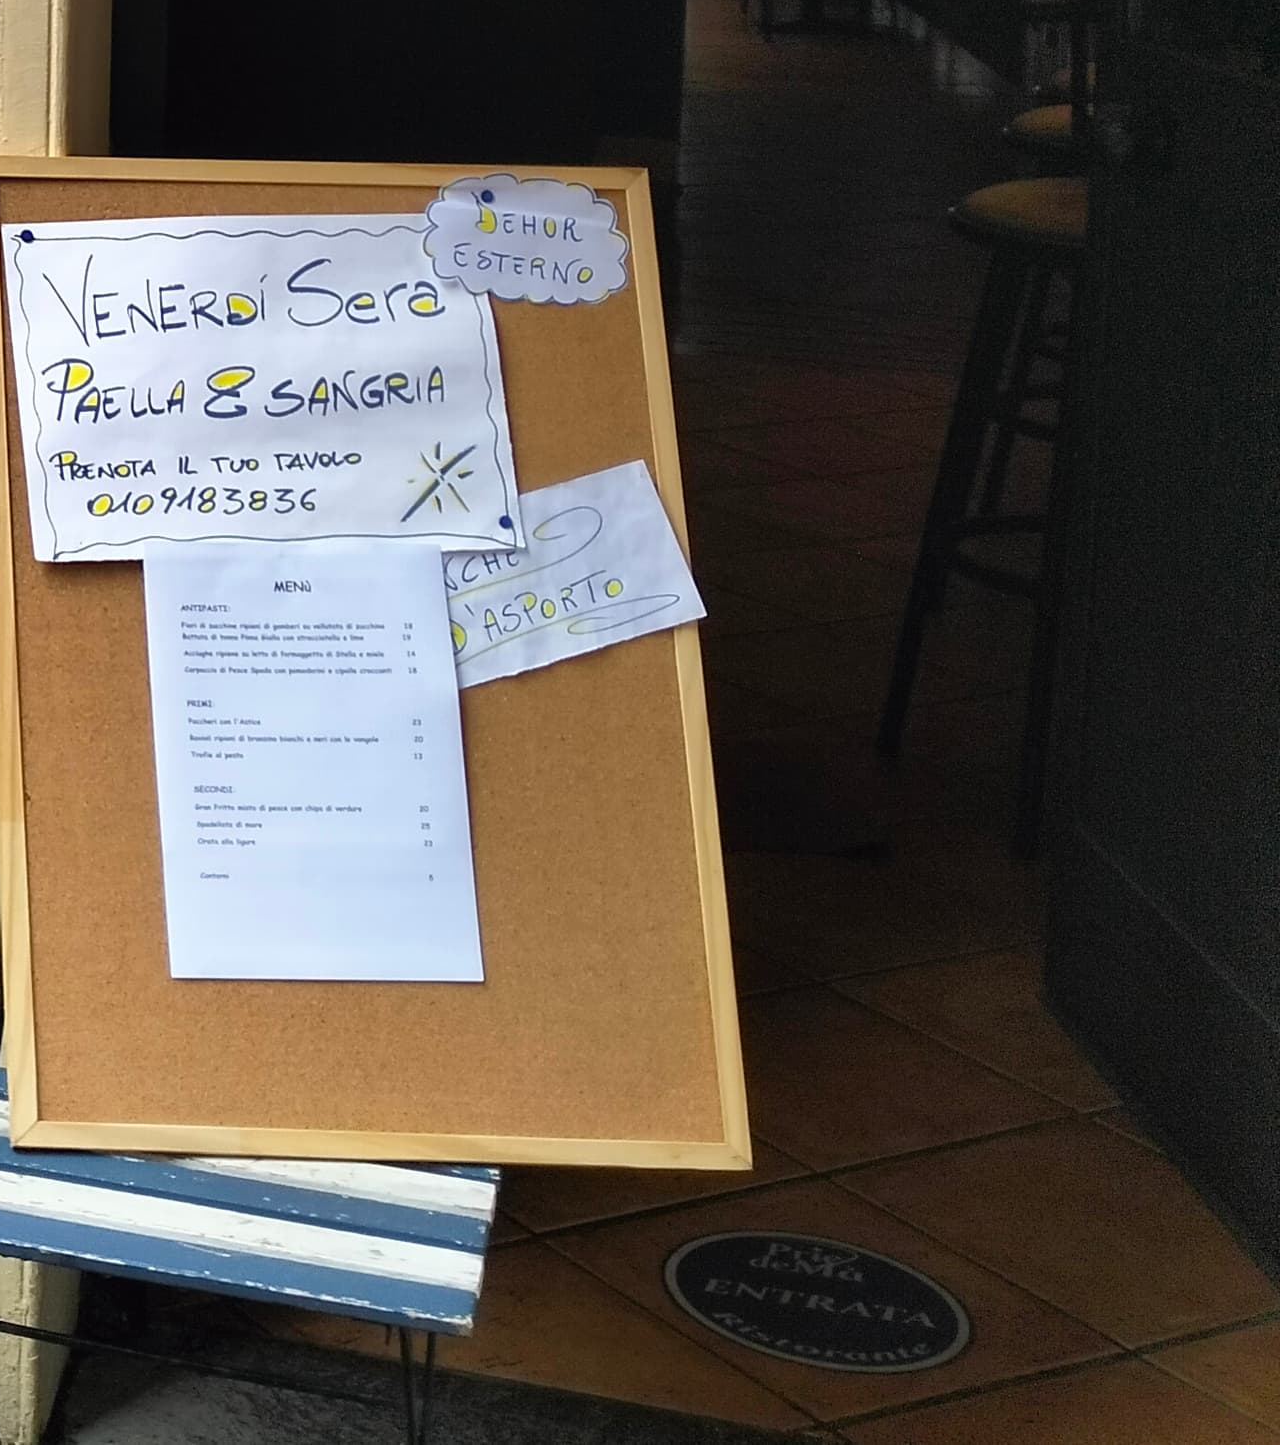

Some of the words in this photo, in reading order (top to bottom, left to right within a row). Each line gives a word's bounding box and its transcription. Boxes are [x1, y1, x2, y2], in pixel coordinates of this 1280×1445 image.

[471, 191, 582, 242] DEHOR
[454, 243, 593, 284] ESTERNO
[42, 358, 185, 424] PAELLA
[264, 366, 445, 418] SANGRIA
[49, 450, 156, 482] PRENOTA
[178, 455, 198, 475] IL
[210, 457, 259, 473] TUO
[274, 452, 362, 472] TAVOLO
[704, 1278, 937, 1328] ENTRATA
